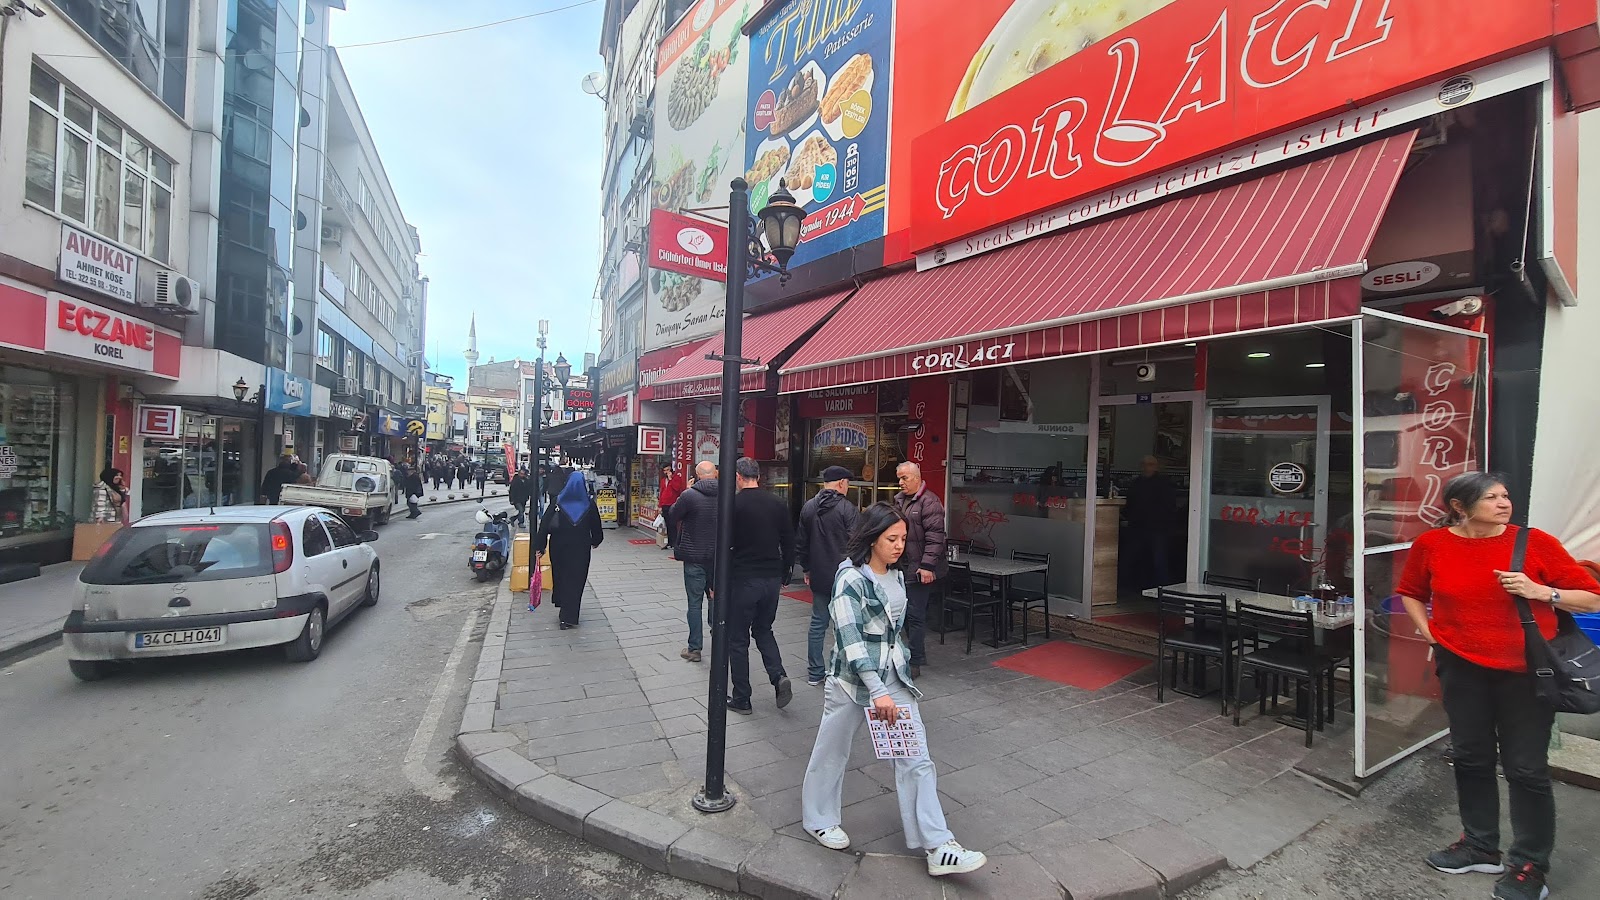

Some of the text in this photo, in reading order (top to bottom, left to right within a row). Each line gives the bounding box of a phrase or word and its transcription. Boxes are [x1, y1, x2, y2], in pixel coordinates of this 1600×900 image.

[824, 13, 874, 60] Patisserie
[846, 158, 857, 168] 310
[846, 168, 857, 178] 06
[820, 173, 830, 181] KIR
[845, 178, 856, 189] 37
[964, 225, 1016, 255] Sıcak
[1023, 211, 1056, 237] bir
[1067, 190, 1139, 226] çorba
[1153, 143, 1260, 196] içinizi
[825, 200, 856, 227] 1944
[66, 231, 133, 274] AVUKAT
[76, 260, 123, 286] AHMET KÖSE
[65, 268, 77, 280] TEL:
[79, 273, 89, 284] 322
[89, 276, 97, 286] 55
[109, 283, 118, 294] 322
[119, 287, 126, 297] 75
[125, 290, 132, 299] 25
[57, 299, 154, 352] ECZANE
[94, 342, 124, 360] KOREL
[283, 373, 304, 398] beko
[570, 390, 592, 398] FOTO
[824, 398, 854, 412] VARDIR
[146, 410, 169, 432] E
[645, 432, 661, 449] E
[143, 628, 218, 646] 34 CLH 041
